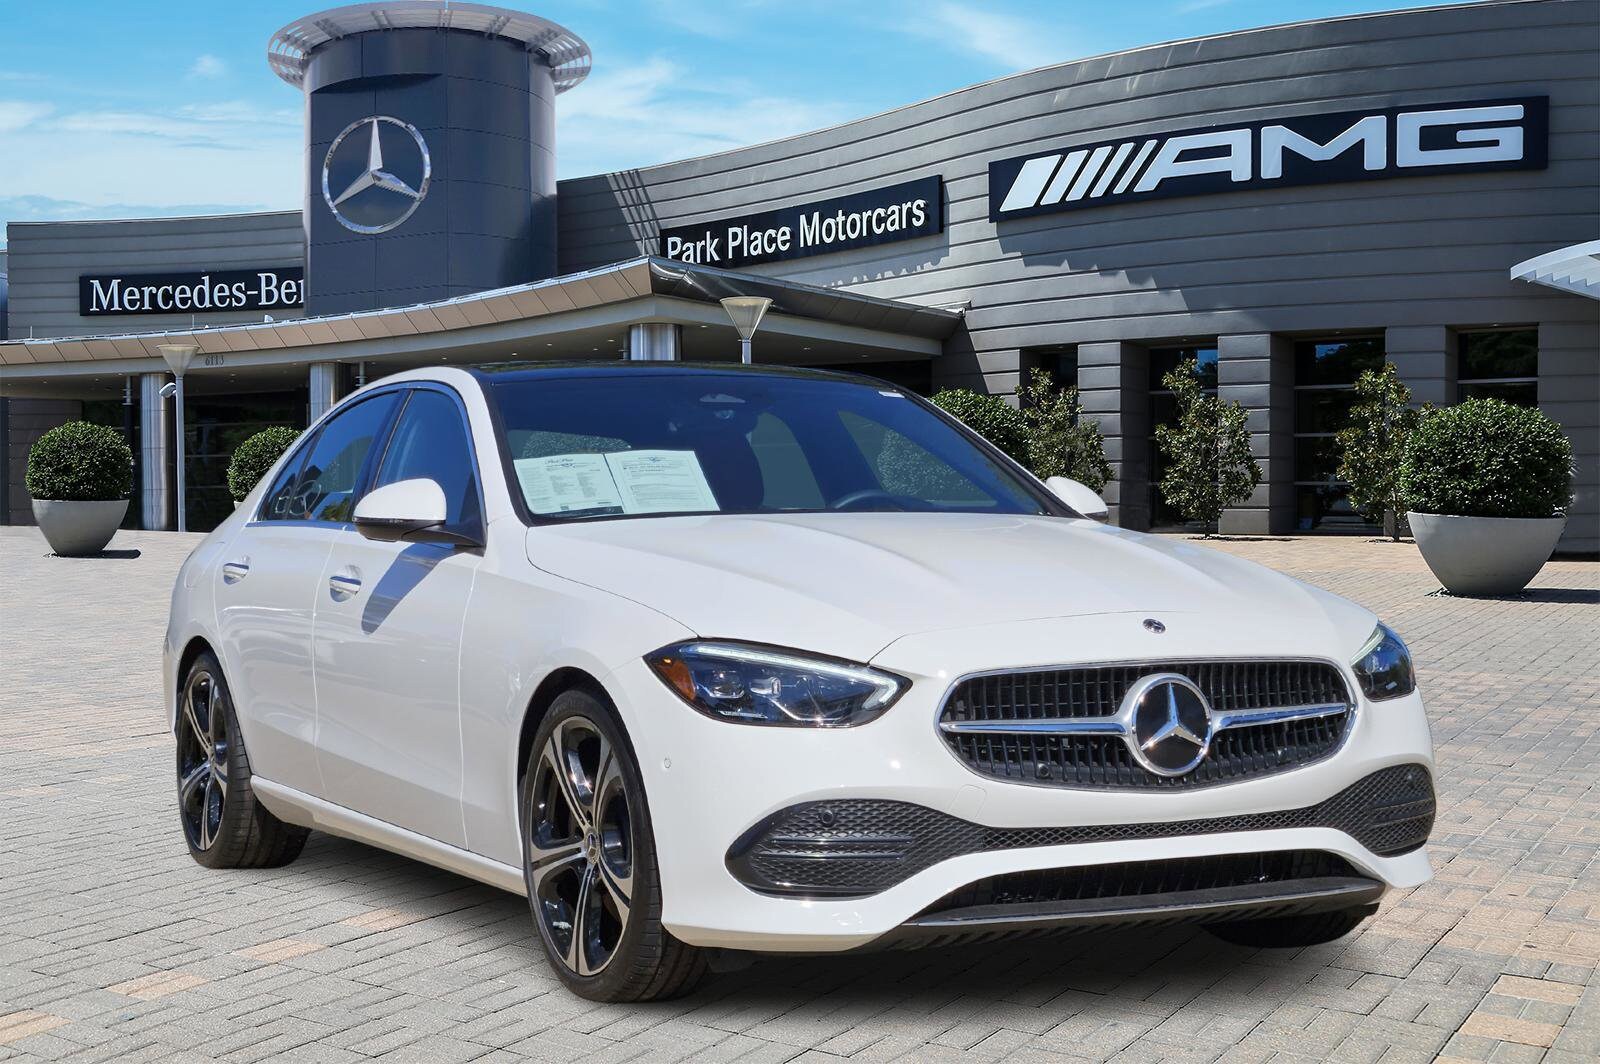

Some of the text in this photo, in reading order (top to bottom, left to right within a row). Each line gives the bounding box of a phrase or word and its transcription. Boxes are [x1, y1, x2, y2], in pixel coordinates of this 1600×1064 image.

[1132, 104, 1524, 193] AMG
[667, 199, 926, 264] Park Place Motorcars
